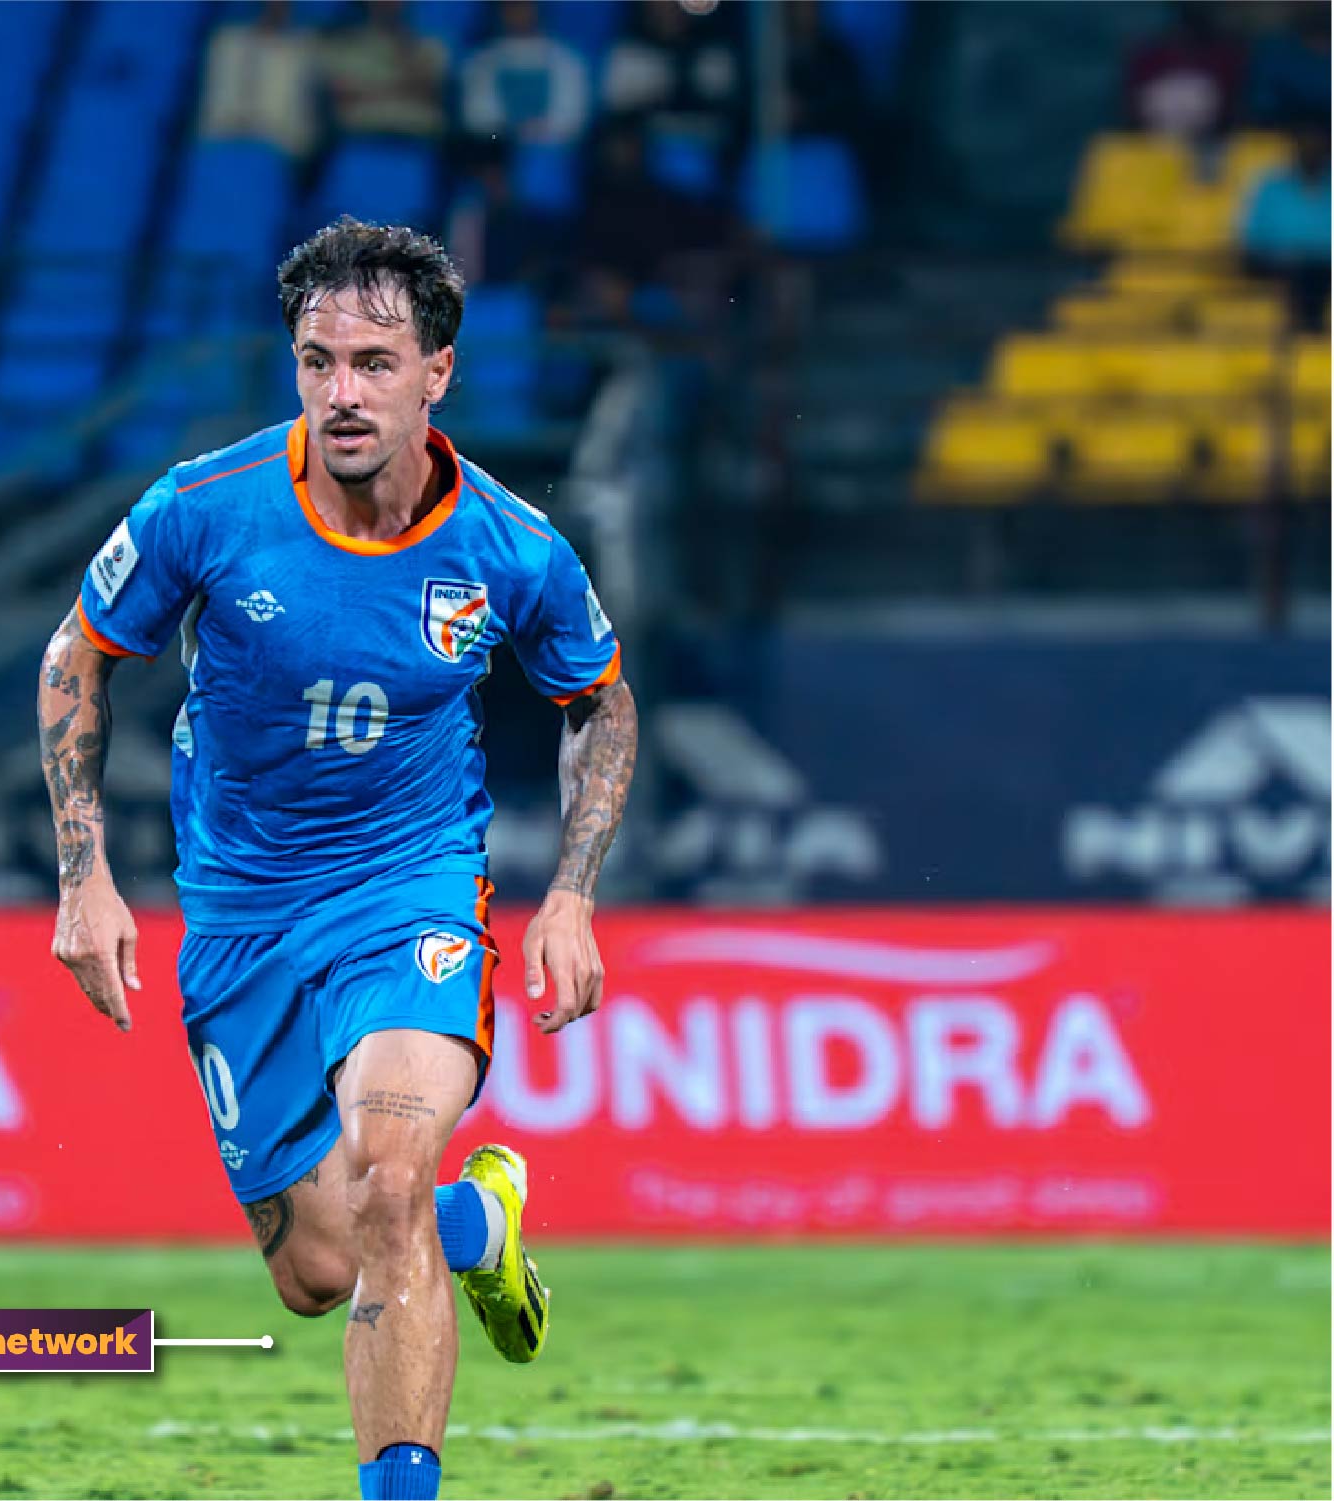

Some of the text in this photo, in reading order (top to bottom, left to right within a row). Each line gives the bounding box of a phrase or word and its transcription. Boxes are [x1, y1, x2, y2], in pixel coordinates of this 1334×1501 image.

[433, 588, 471, 600] INDIA
[301, 678, 390, 755] 10
[189, 1042, 240, 1131] 0
[456, 992, 1156, 1132] UNIDRA
